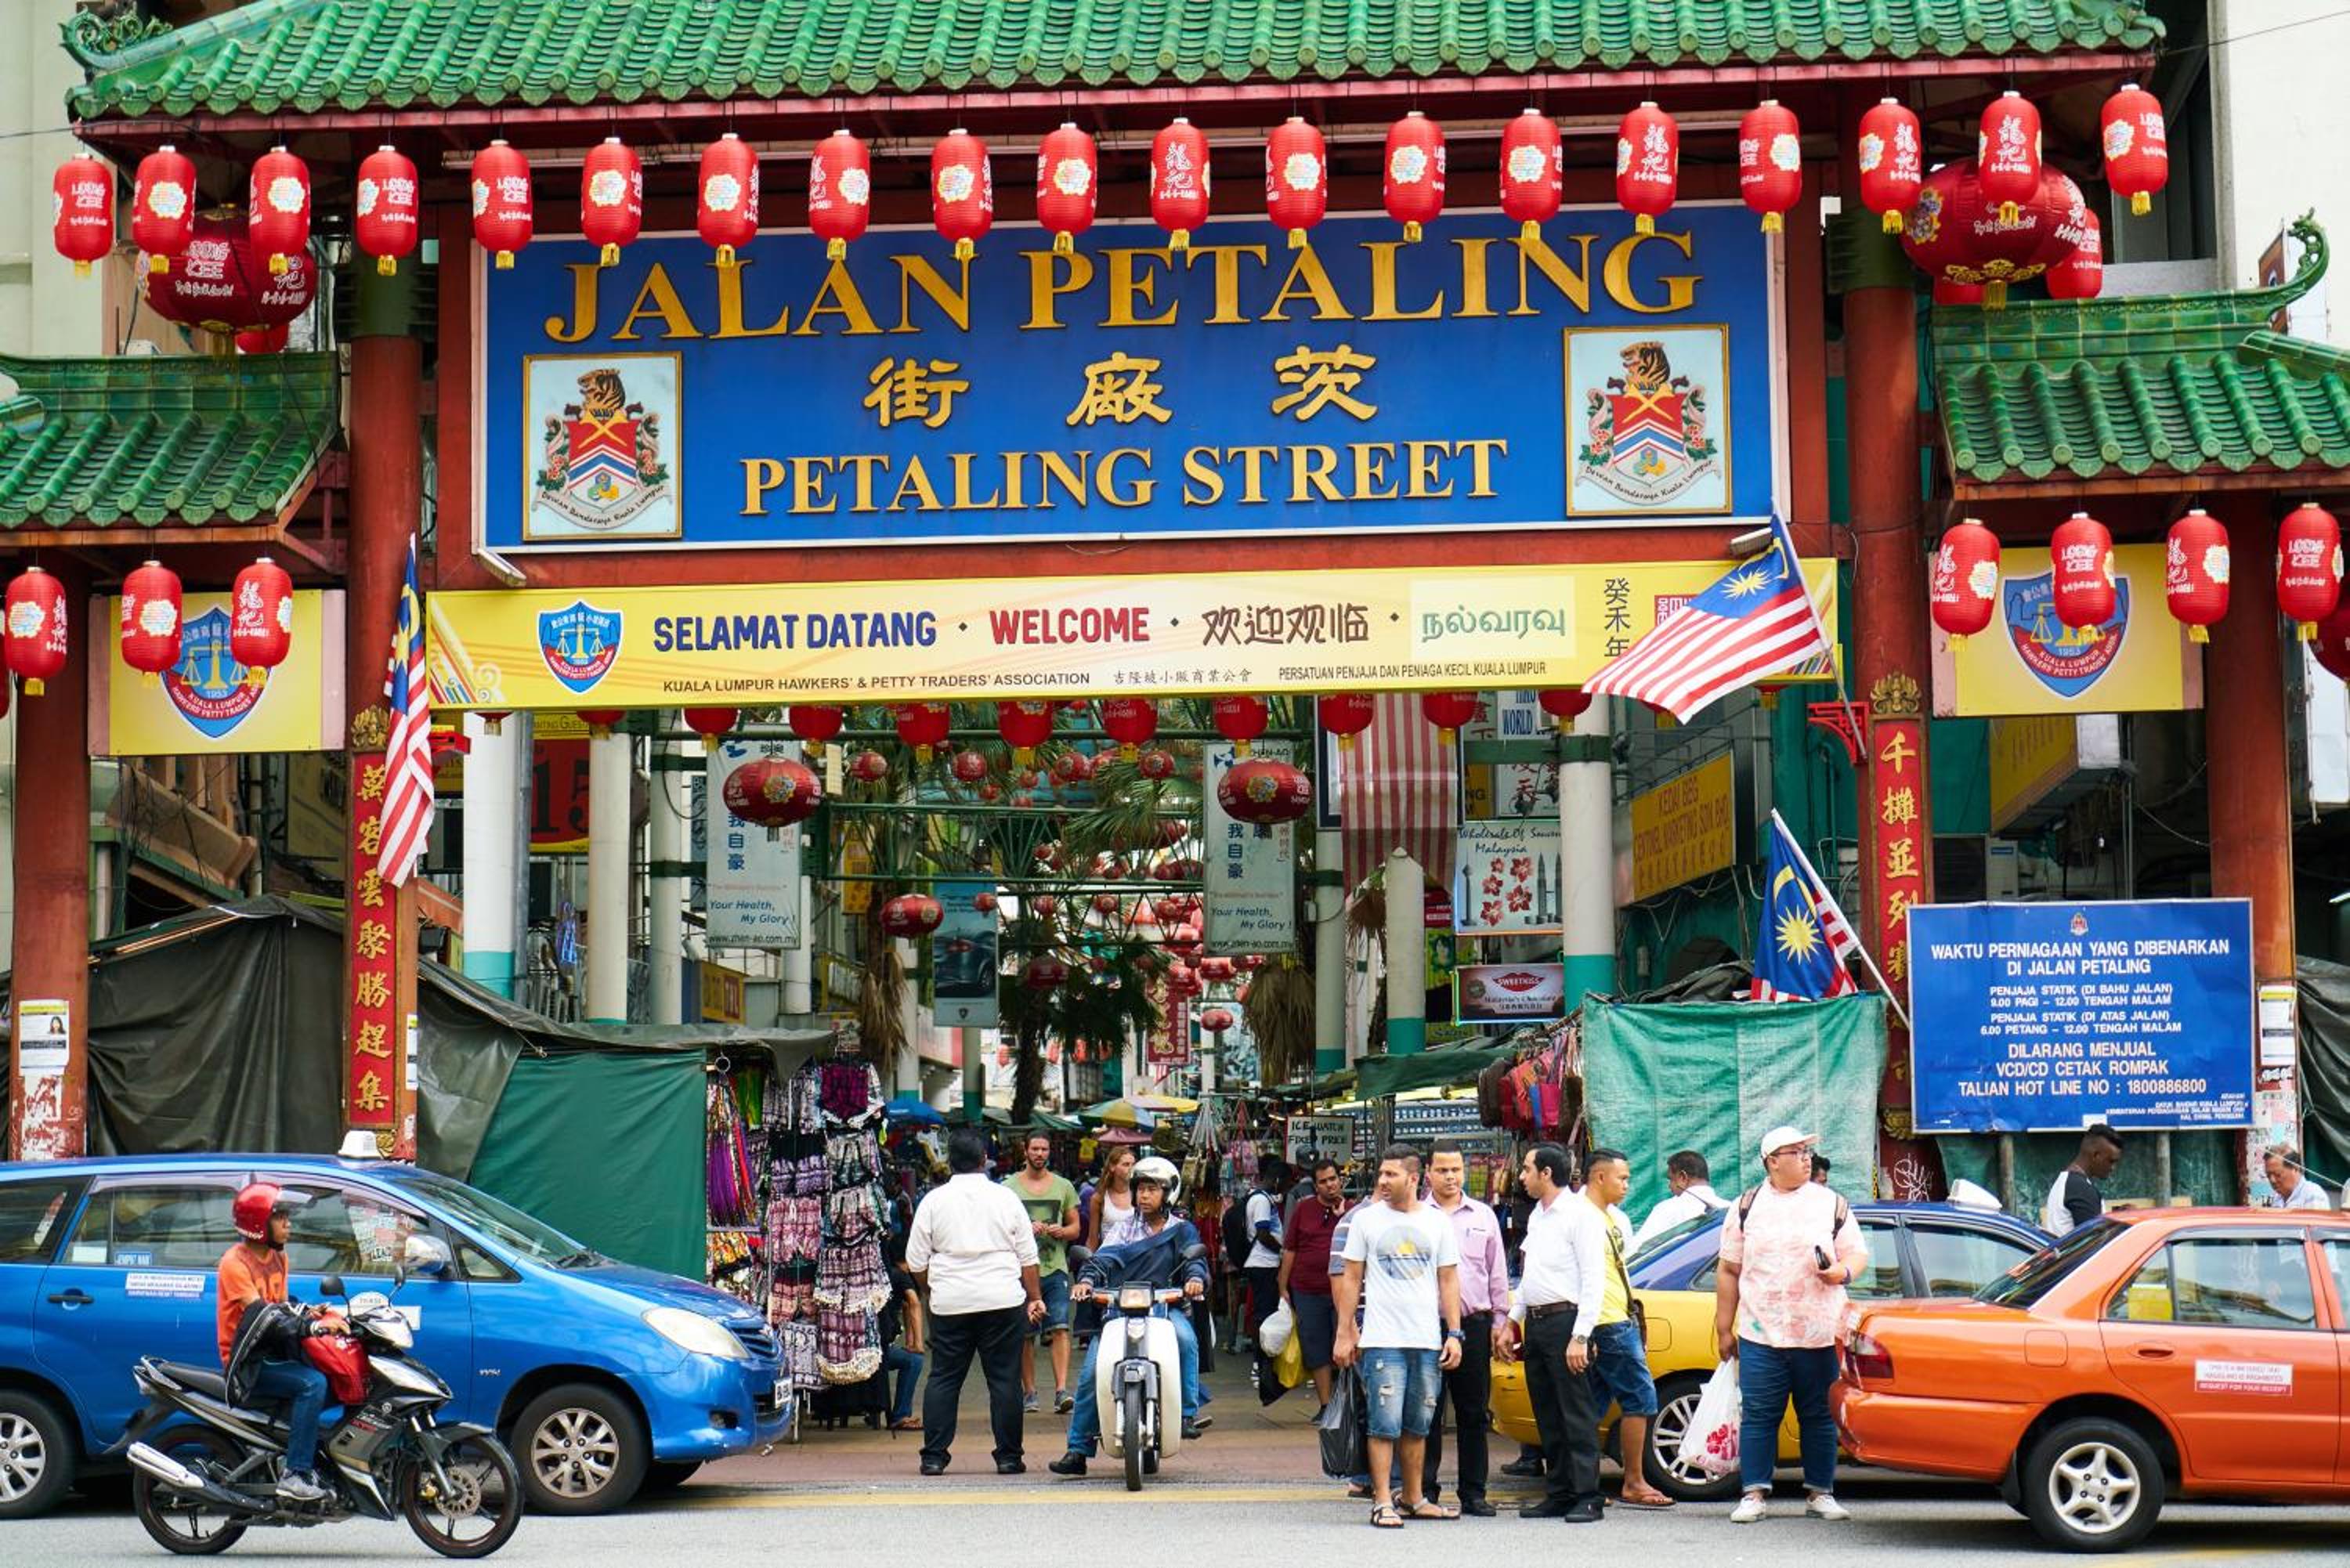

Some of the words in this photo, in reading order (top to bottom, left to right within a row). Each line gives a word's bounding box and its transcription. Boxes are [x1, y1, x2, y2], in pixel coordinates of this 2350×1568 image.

[546, 253, 979, 343] JALAN
[1019, 230, 1703, 329] PETALING
[740, 448, 1158, 516] PETALING
[1184, 439, 1507, 505] STREET
[654, 613, 800, 652] SELAMAT
[807, 611, 937, 649] DATANG
[989, 607, 1150, 645] WELCOME
[1202, 602, 1369, 646] 欢迎观临
[1279, 666, 1333, 680] PERSATUAN
[1336, 665, 1377, 678] PENJAJA
[1380, 665, 1398, 677] DAN
[1401, 663, 1443, 677] PENIAGA
[1444, 663, 1470, 676] KECIL
[1473, 663, 1506, 675] KUALA
[1508, 662, 1546, 674] LUMPUR
[663, 681, 710, 693] KUALA
[715, 680, 774, 692] LUMPUR
[857, 678, 867, 690] &
[871, 677, 916, 690] PETTY
[994, 672, 1090, 687] ASSOCIATION
[1502, 709, 1534, 735] WORLD
[1475, 843, 1528, 857] Malaysia
[710, 901, 733, 910] Your
[736, 900, 776, 912] Health,
[1212, 907, 1233, 916] Your
[1235, 907, 1273, 918] Health,
[740, 914, 757, 925] My
[759, 913, 788, 925] Glory
[1240, 919, 1255, 930] My
[1257, 919, 1285, 930] Glory
[1931, 944, 1984, 960] WAKTU
[1989, 942, 2084, 959] PERNIAGAAN
[2089, 941, 2128, 956] YANG
[2135, 940, 2229, 956] DIBENARKAN
[2007, 961, 2021, 976] DI
[2027, 960, 2076, 975] JALAN
[2081, 959, 2151, 974] PETALING
[1990, 985, 2037, 996] PENJAJA
[2041, 985, 2076, 995] STATIK
[2081, 984, 2095, 995] (DI
[2099, 984, 2130, 995] BAHU
[2134, 983, 2173, 995] JALAN)
[1990, 997, 2011, 1008] 9.00
[2015, 997, 2038, 1007] PAGI
[2055, 996, 2080, 1006] 12.00
[2084, 995, 2128, 1006] TENGAH
[2131, 995, 2171, 1006] MALAM
[1990, 1012, 2037, 1024] PENJAJA
[2041, 1011, 2076, 1023] STATIK
[2081, 1010, 2095, 1023] (DI
[2100, 1010, 2128, 1021] ATAS
[2131, 1010, 2170, 1022] JALAN)
[1980, 1025, 2001, 1035] 6.00
[2005, 1024, 2048, 1035] PETANG
[2063, 1024, 2089, 1034] 12.00
[2093, 1023, 2138, 1034] TENGAH
[2142, 1022, 2182, 1033] MALAM
[2008, 1043, 2084, 1058] DILARANG
[2090, 1042, 2157, 1057] MENJUAL
[1996, 1062, 2050, 1078] VCD/CD
[2055, 1061, 2102, 1076] CETAK
[2110, 1060, 2168, 1075] ROMPAK
[1959, 1082, 2009, 1097] TALIAN
[2015, 1081, 2044, 1096] HOT
[2051, 1080, 2082, 1095] LINE
[2088, 1080, 2109, 1094] NO
[2127, 1078, 2207, 1094] 1800886800
[1292, 1121, 1309, 1130] ICE
[1313, 1121, 1344, 1133] WATCH
[1321, 1135, 1345, 1145] PRICE
